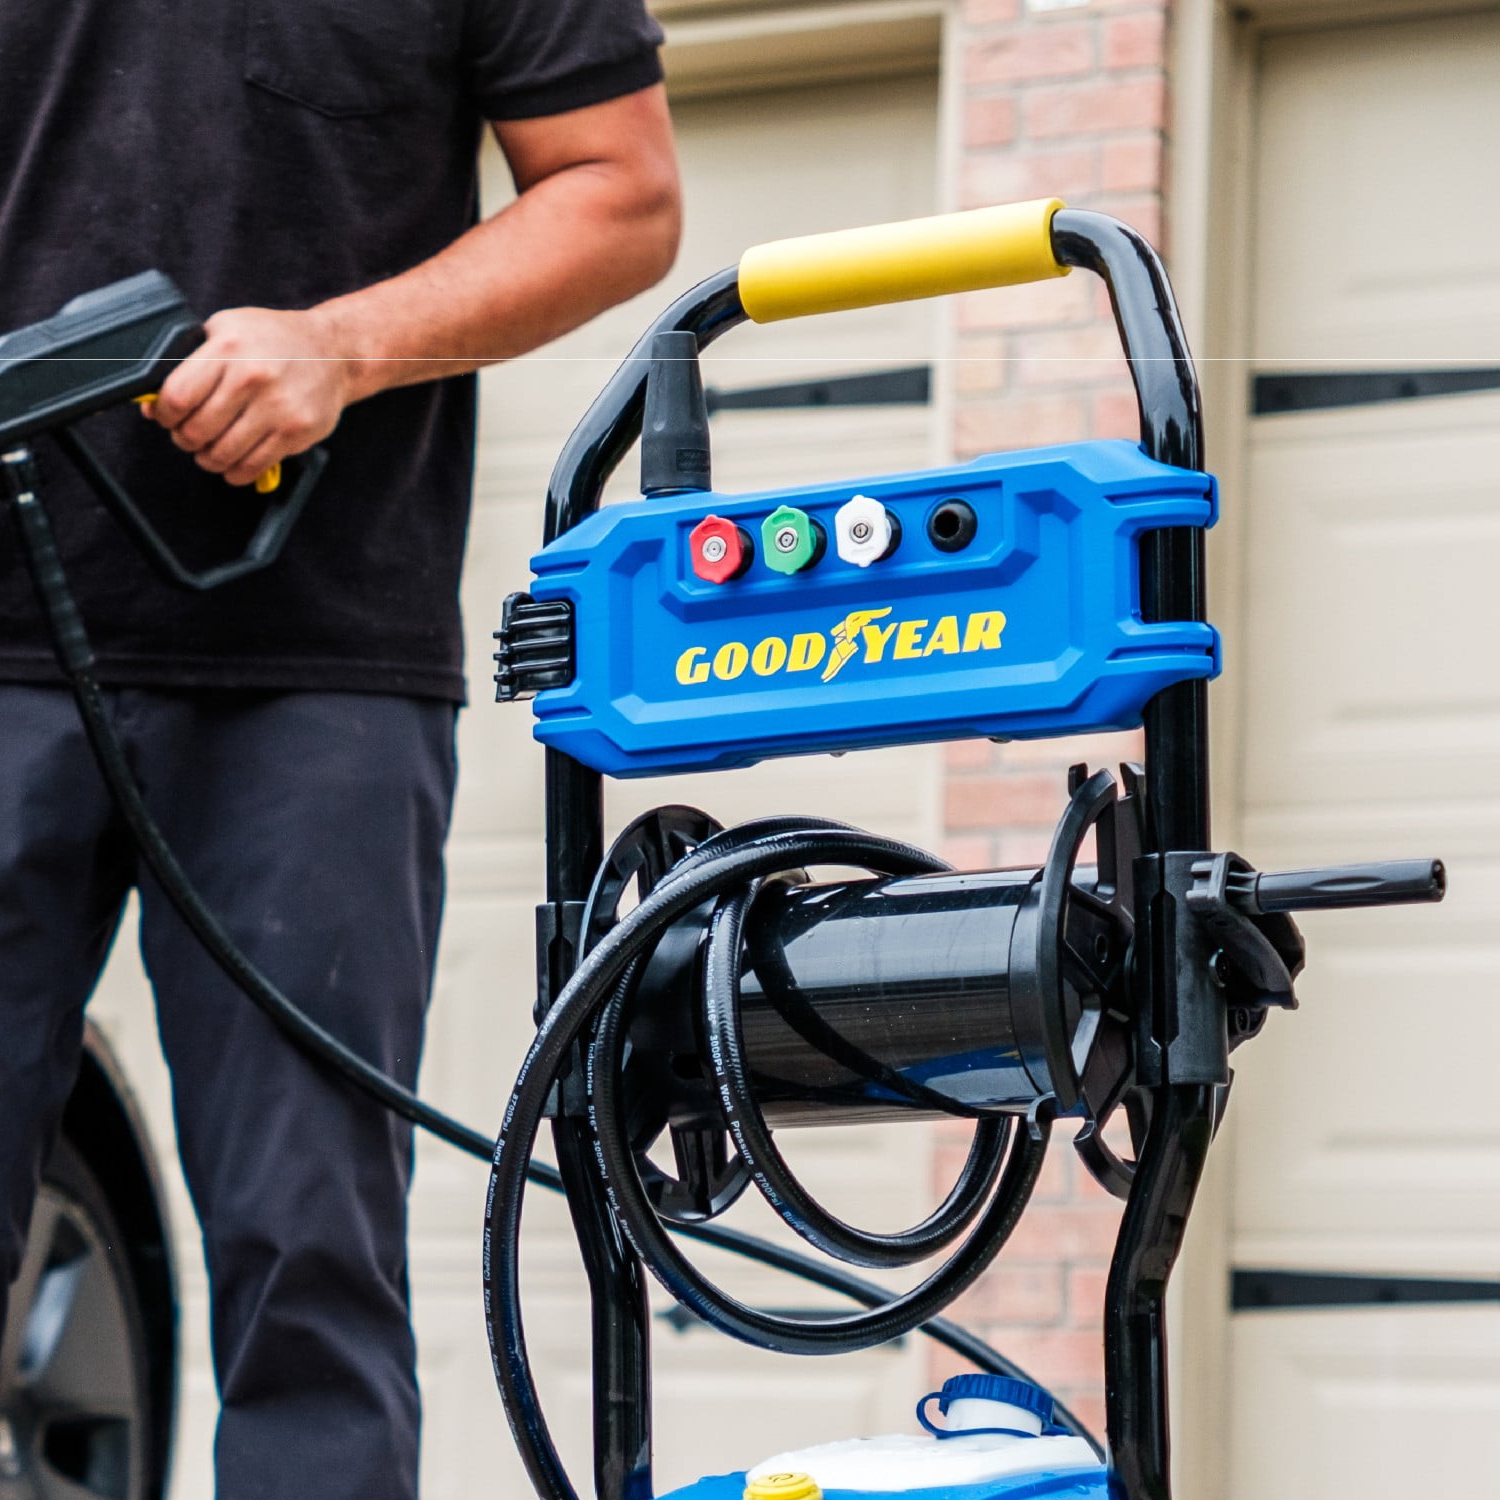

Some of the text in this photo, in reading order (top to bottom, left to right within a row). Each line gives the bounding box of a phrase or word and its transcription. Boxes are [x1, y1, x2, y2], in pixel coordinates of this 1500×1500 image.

[675, 606, 1007, 685] GOODYEAR
[517, 1043, 541, 1086] Pressure
[586, 1042, 597, 1096] Industries
[592, 1139, 609, 1179] 3000Psi
[605, 1185, 621, 1213] Work
[709, 1034, 725, 1077] 3000Psi
[719, 1083, 735, 1113] Work
[730, 1119, 755, 1167] Pressure
[754, 1171, 783, 1208] 8700Psi
[485, 1172, 498, 1219] Maximum
